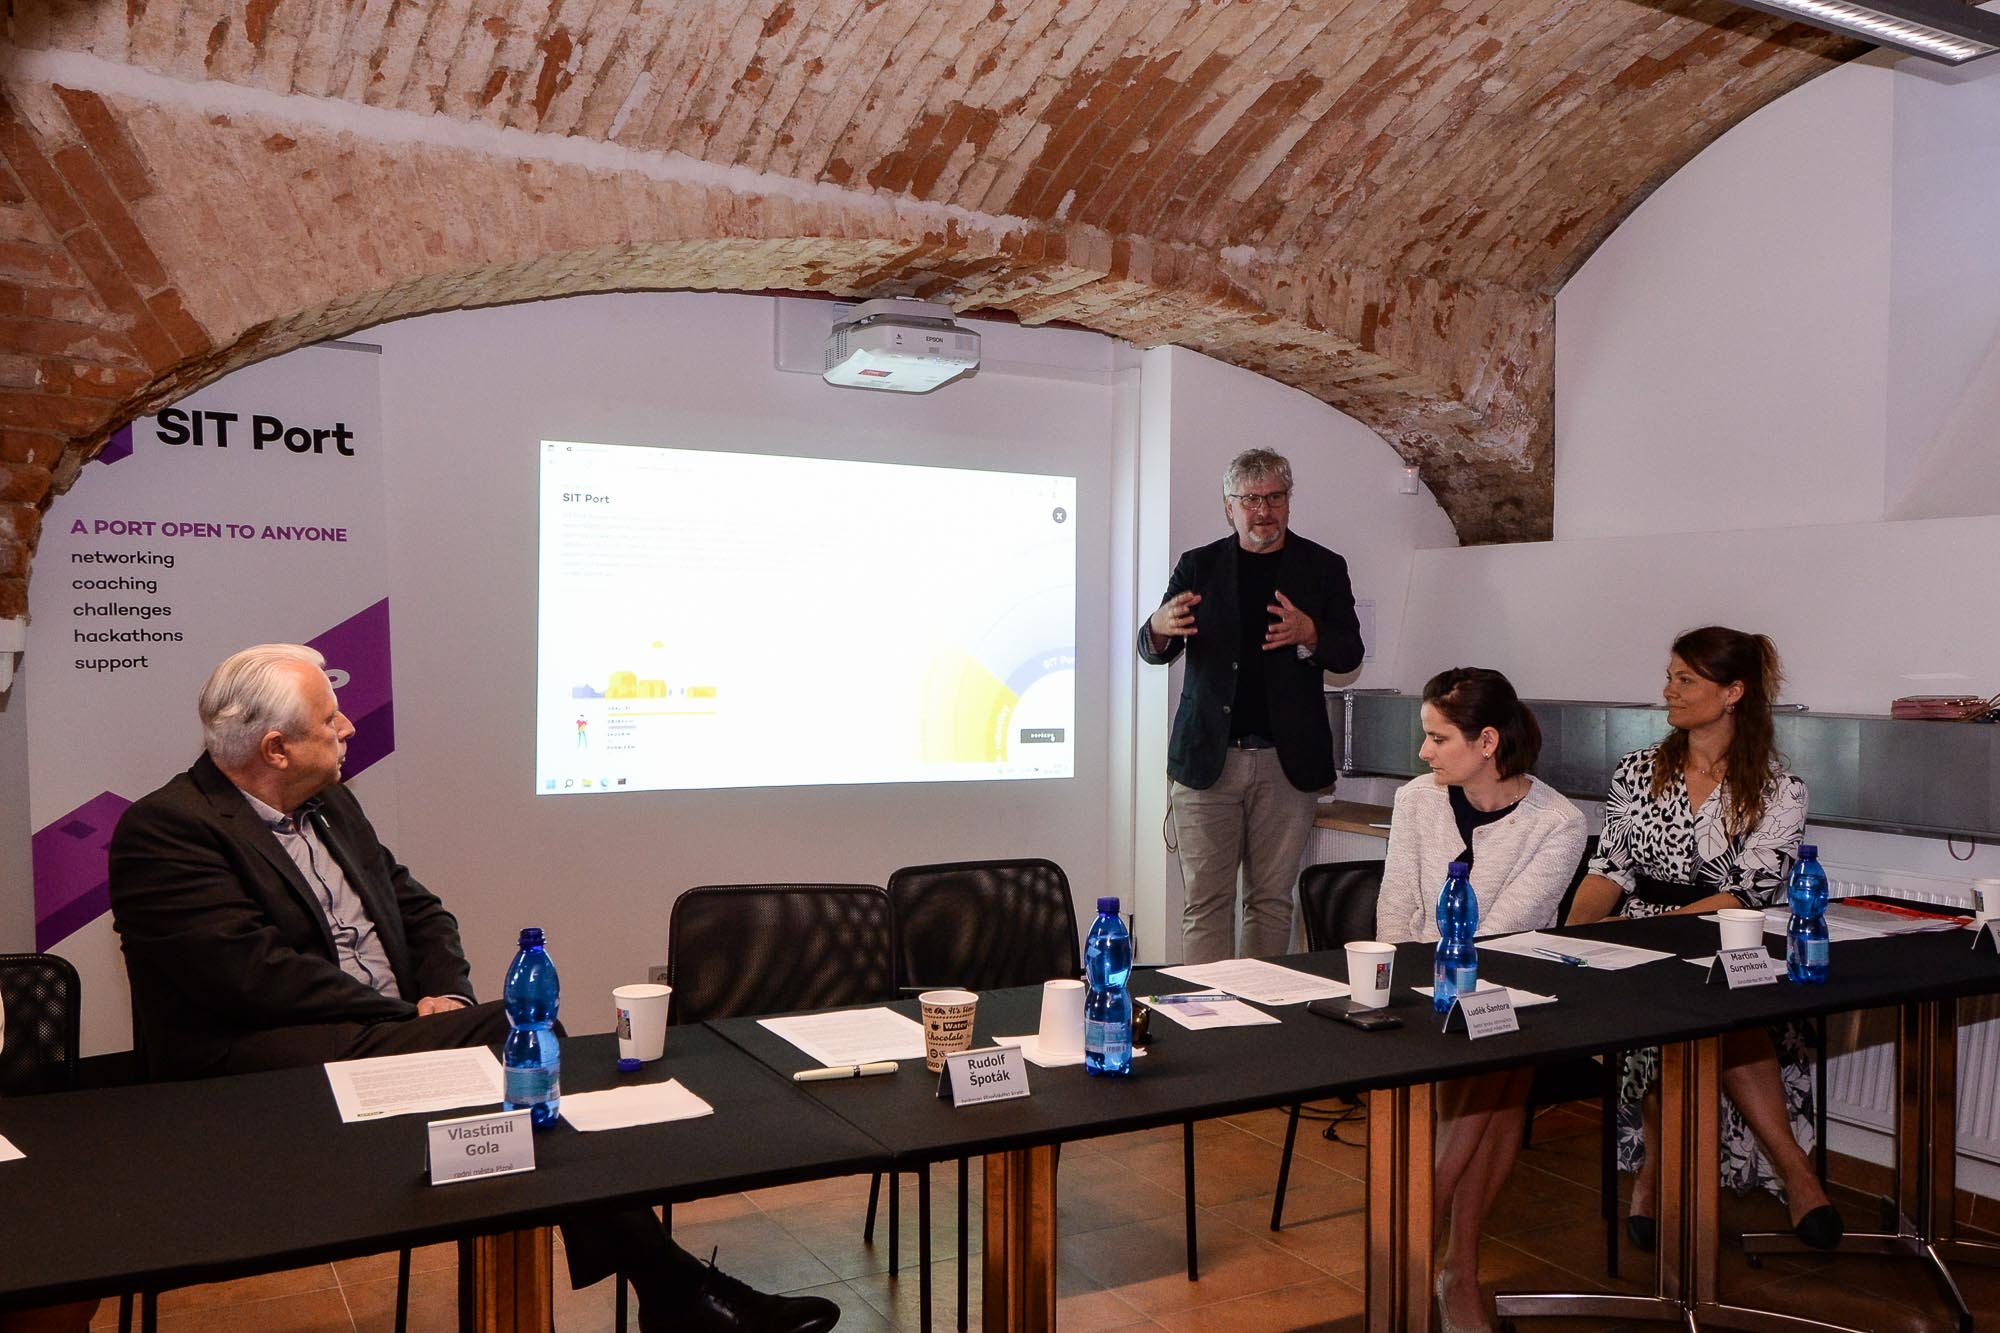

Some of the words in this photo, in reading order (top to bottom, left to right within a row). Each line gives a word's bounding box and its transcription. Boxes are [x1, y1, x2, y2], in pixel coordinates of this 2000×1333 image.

[156, 408, 239, 449] SIT
[252, 414, 355, 457] Port
[562, 492, 582, 503] SIT
[585, 493, 611, 504] Port
[70, 519, 88, 534] A
[94, 519, 157, 536] PORT
[161, 521, 222, 538] OPEN
[225, 524, 256, 540] TO
[260, 525, 348, 543] ANYONE
[71, 550, 175, 569] networking
[72, 576, 158, 594] coaching
[73, 602, 172, 620] challenges
[74, 628, 184, 643] hackathons
[74, 655, 149, 673] support
[1730, 951, 1759, 961] Martina
[1729, 961, 1768, 973] Surynková
[1467, 1006, 1487, 1017] Luděk
[1486, 1003, 1510, 1013] Šantora
[944, 1022, 968, 1030] Water
[967, 1054, 1006, 1070] Rudolf
[970, 1070, 1010, 1087] Špoták
[447, 1121, 514, 1141] Vlastimil
[465, 1141, 500, 1157] Gola
